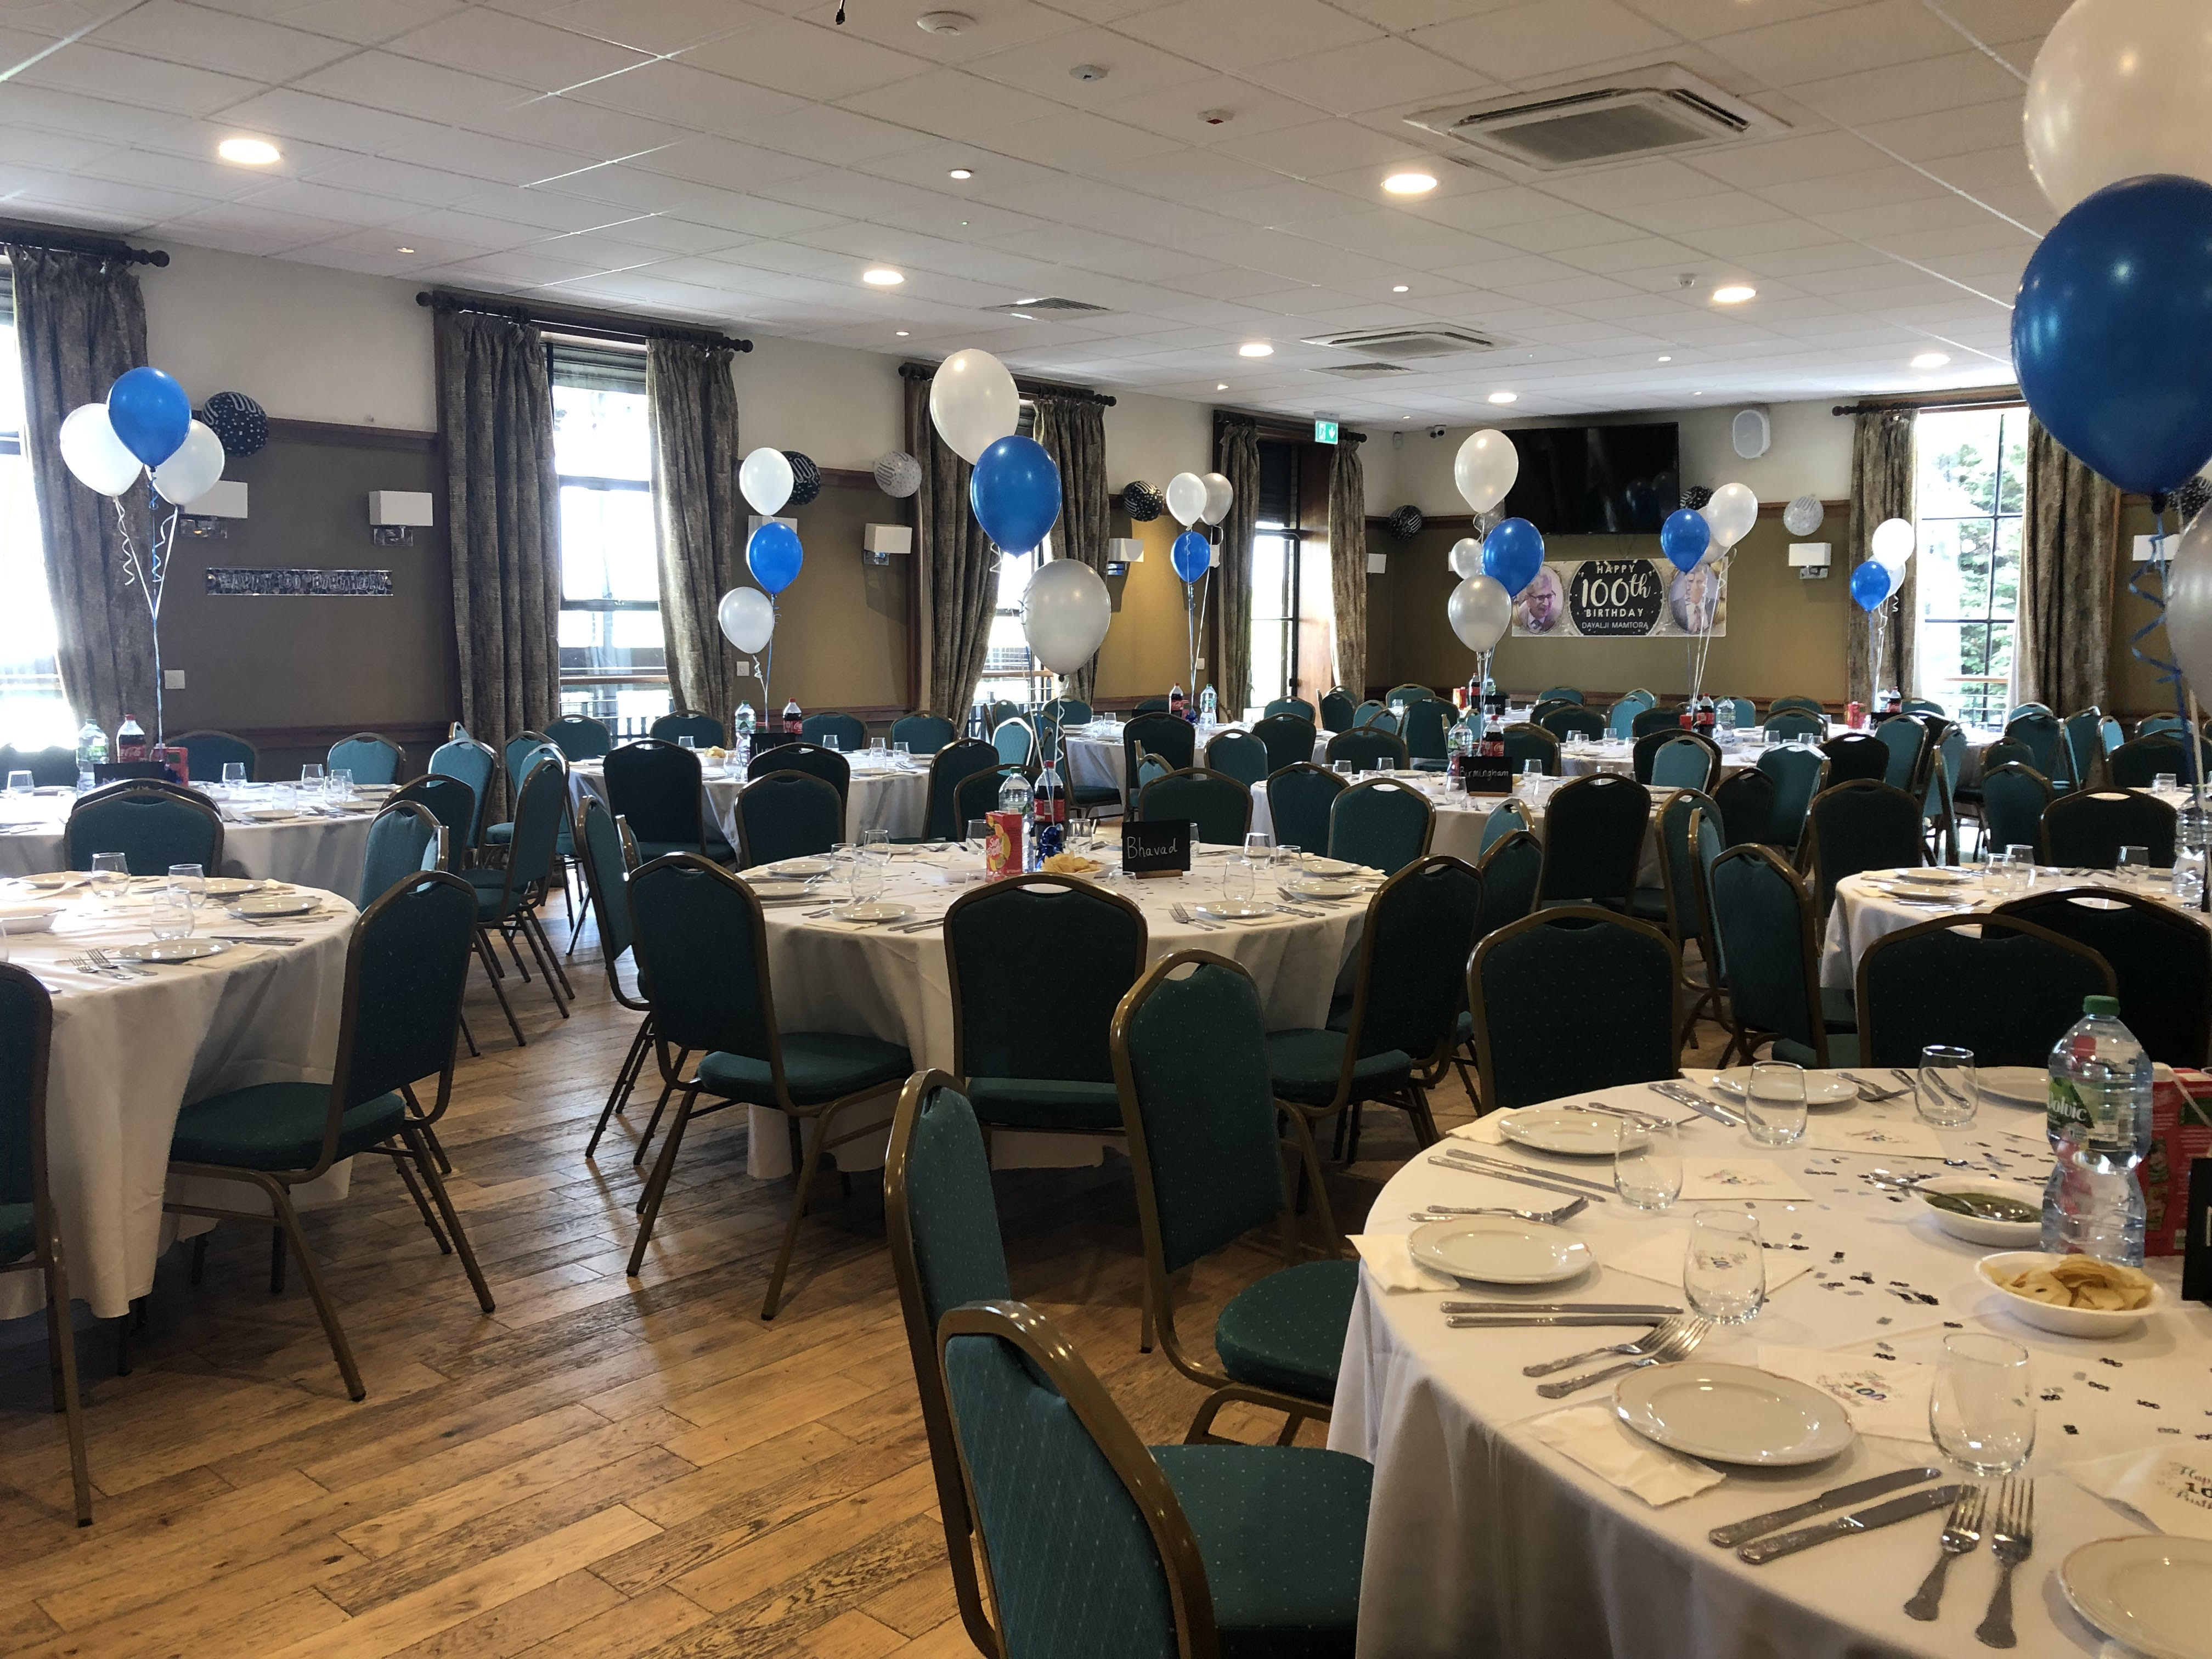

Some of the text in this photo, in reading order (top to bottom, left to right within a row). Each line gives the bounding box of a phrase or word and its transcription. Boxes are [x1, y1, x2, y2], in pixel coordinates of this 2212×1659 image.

[1597, 564, 1635, 574] HAPPY
[1582, 573, 1651, 608] 100th
[1585, 608, 1644, 617] BIRTHDAY
[1127, 836, 1178, 859] Bhavad
